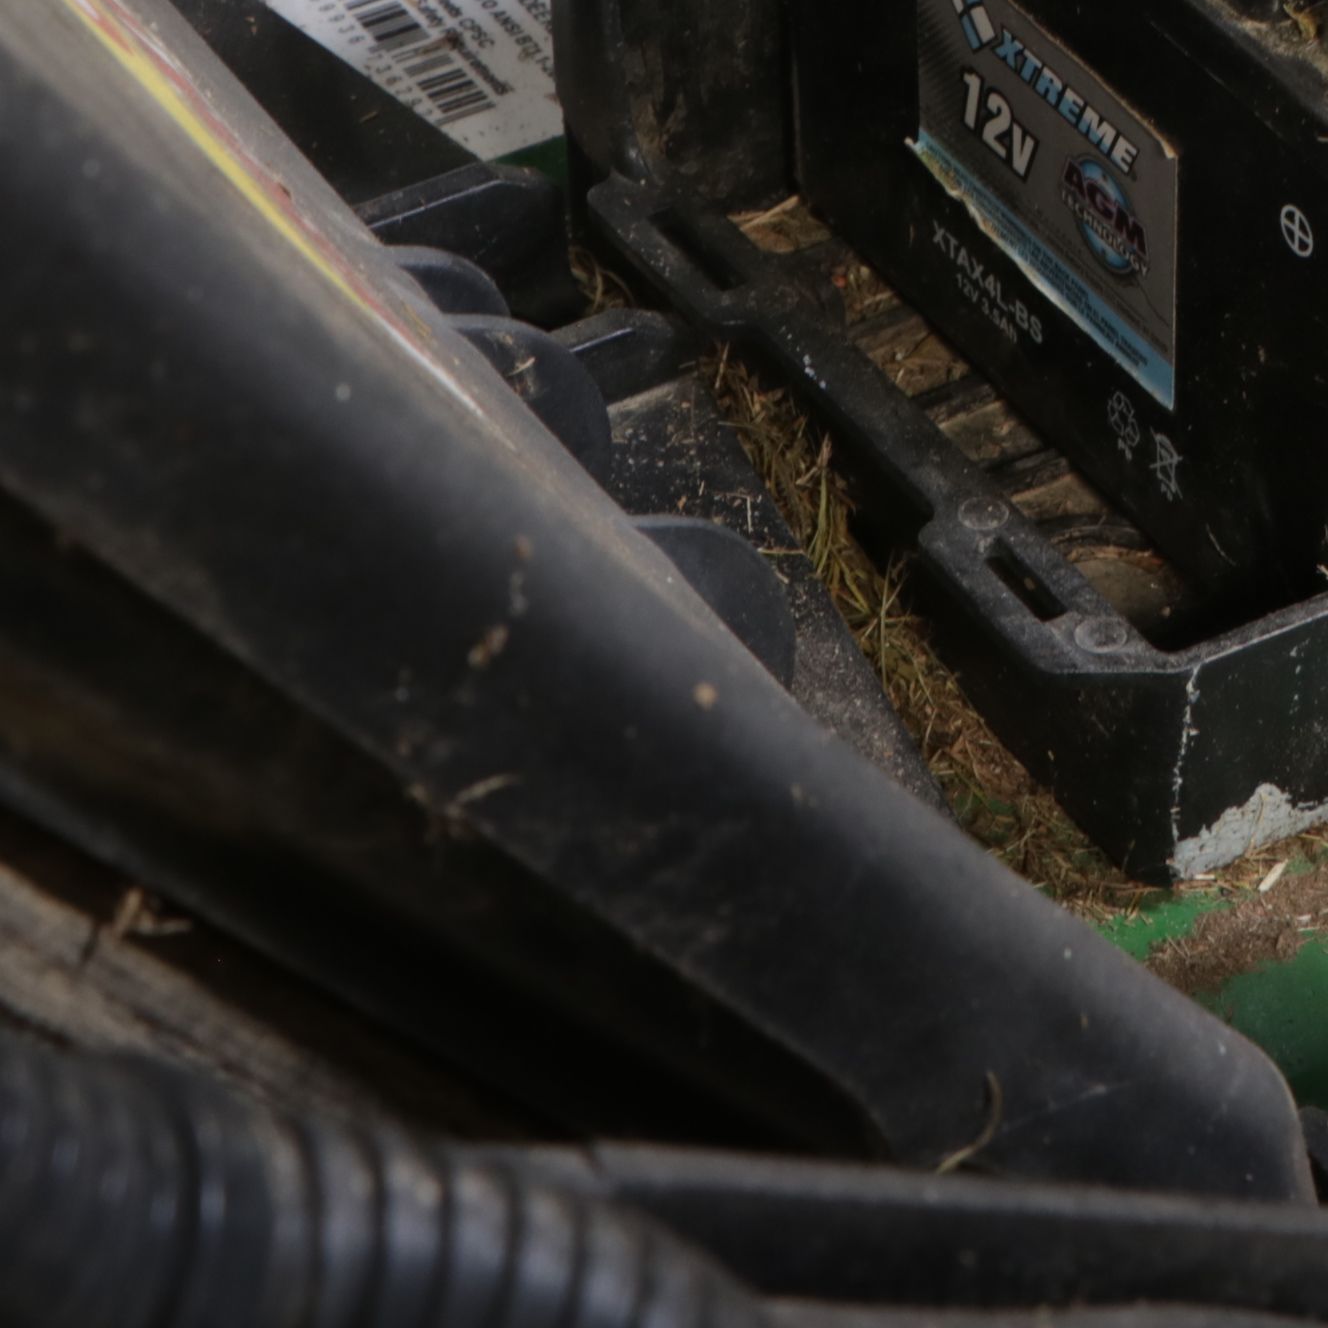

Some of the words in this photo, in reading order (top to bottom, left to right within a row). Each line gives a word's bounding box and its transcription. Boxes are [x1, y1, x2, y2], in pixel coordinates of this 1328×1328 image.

[459, 17, 496, 49] CPSC
[489, 9, 525, 37] ANSI
[994, 28, 1140, 175] XTREME
[1061, 189, 1149, 277] TECHNOLOGY
[1063, 156, 1148, 255] AGM
[932, 222, 1043, 345] XTAX4L-BS
